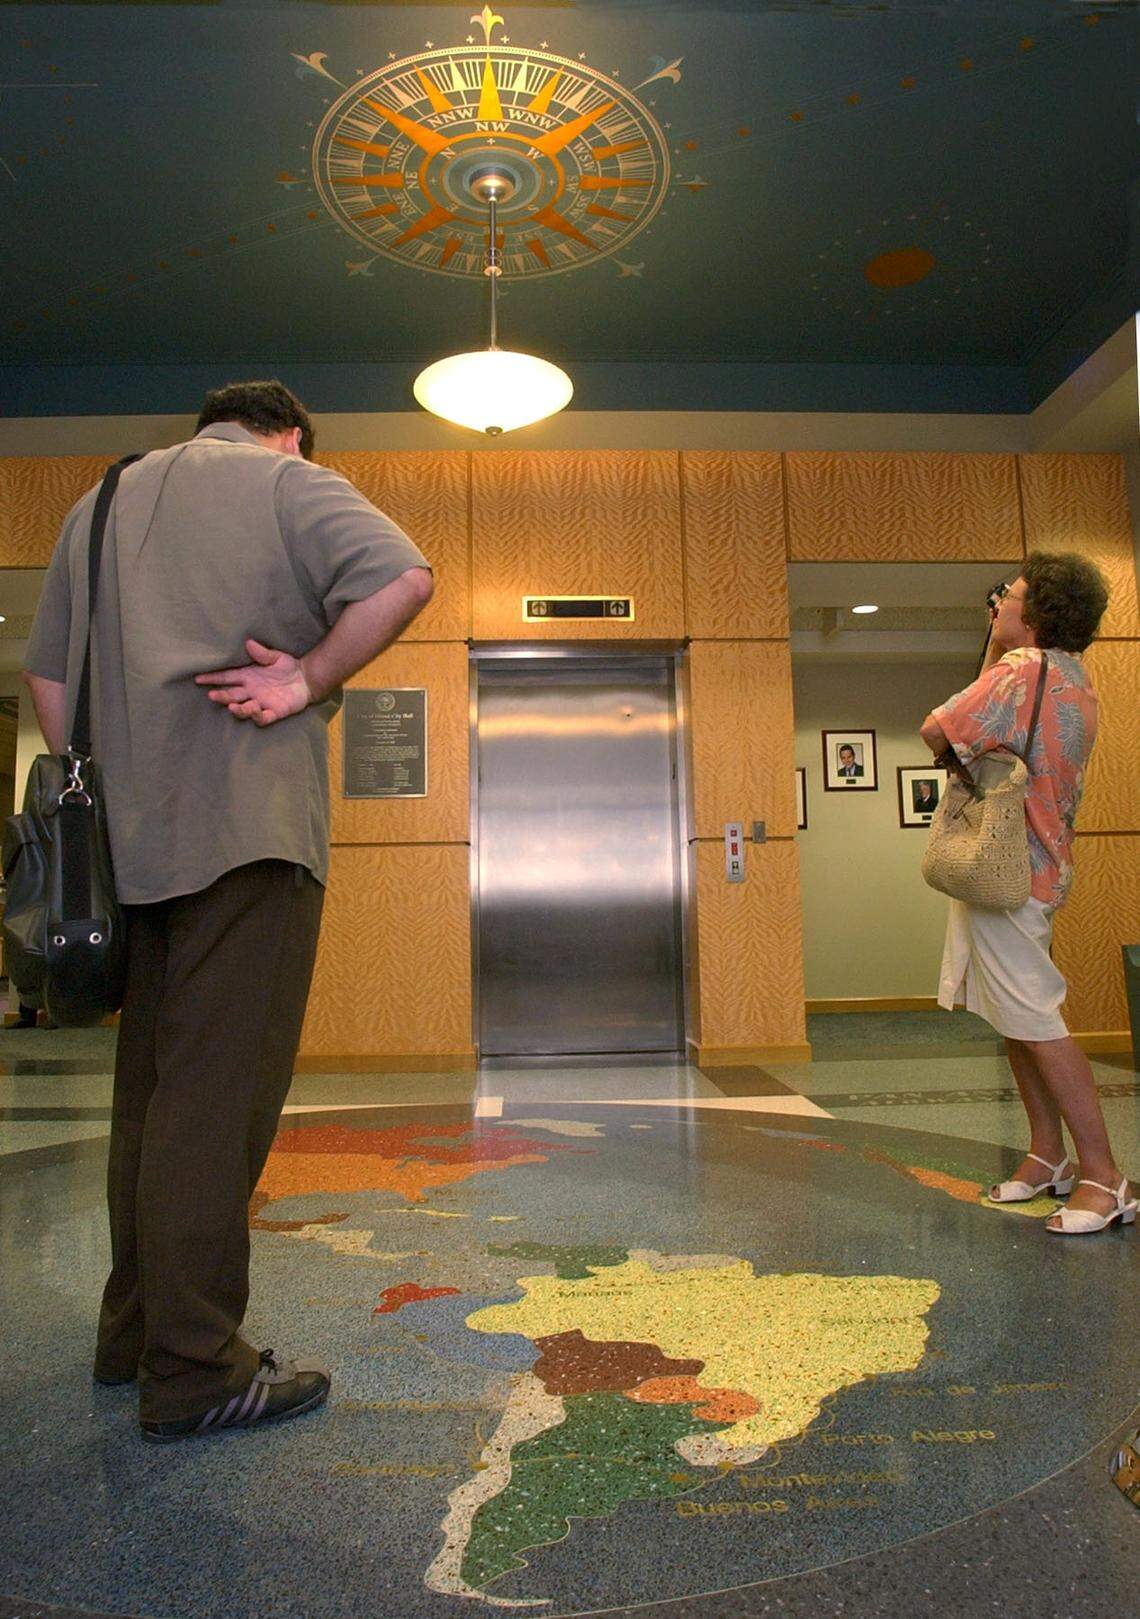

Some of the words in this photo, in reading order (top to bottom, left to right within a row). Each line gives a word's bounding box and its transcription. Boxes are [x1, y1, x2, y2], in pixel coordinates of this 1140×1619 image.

[428, 107, 474, 128] NNW
[474, 121, 511, 132] NW
[508, 108, 557, 130] WNW
[387, 141, 410, 169] NNE
[440, 147, 456, 160] N
[526, 146, 545, 160] W
[573, 142, 597, 172] WSW
[406, 171, 420, 191] NE
[559, 1291, 633, 1299] Manaus
[821, 1433, 894, 1446] Porto
[911, 1429, 997, 1444] Alegre
[675, 1498, 790, 1516] Buenos
